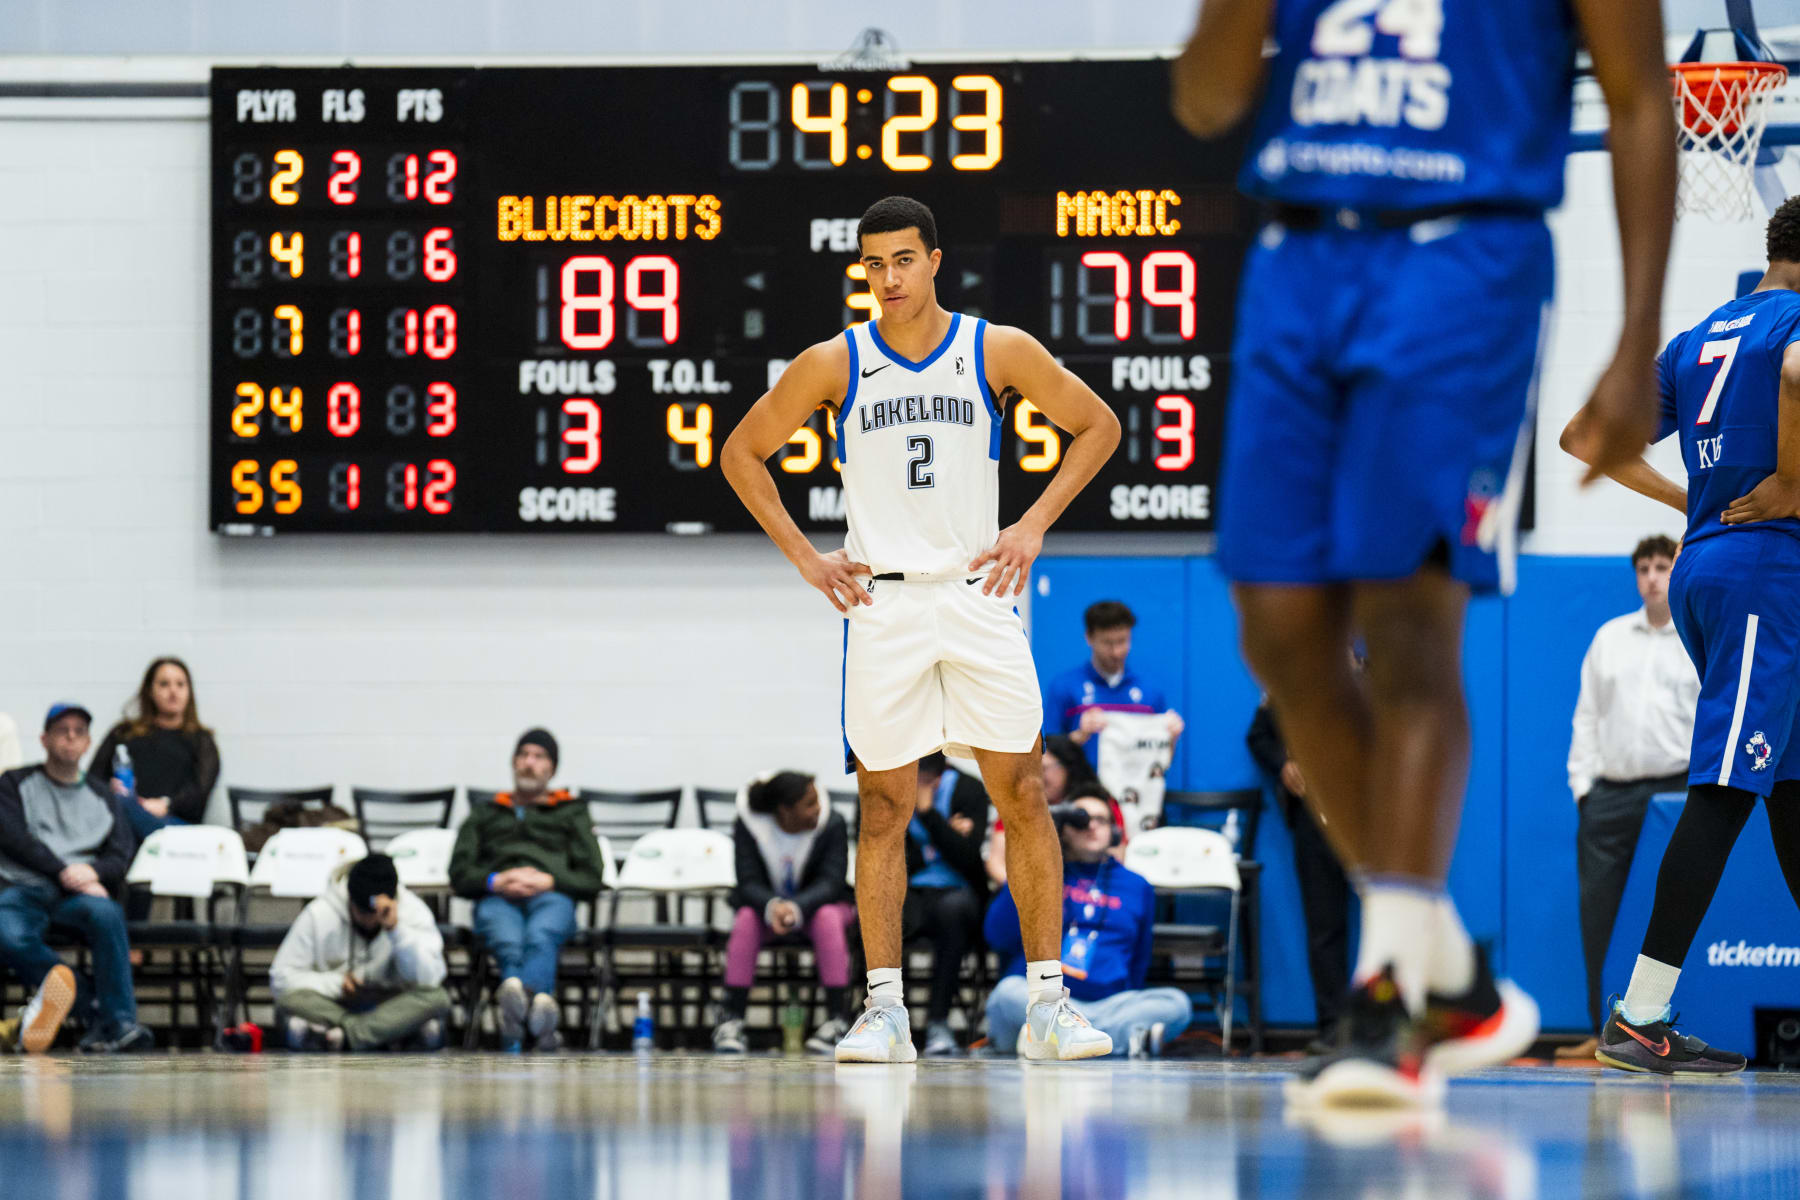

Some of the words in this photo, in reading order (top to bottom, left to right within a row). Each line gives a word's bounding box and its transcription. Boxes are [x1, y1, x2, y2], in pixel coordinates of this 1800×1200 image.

[1311, 0, 1444, 58] 24
[236, 89, 296, 122] PLYR
[322, 89, 365, 122] FLS
[397, 89, 443, 122] PTS
[791, 74, 1002, 171] 4:23
[270, 150, 304, 205] 2
[328, 150, 361, 205] 2
[405, 150, 458, 205] 12
[498, 195, 721, 241] BLUECOATS
[810, 218, 862, 252] PER
[1057, 190, 1181, 236] MAGIC
[270, 231, 303, 278] 4
[348, 231, 361, 278] 1
[423, 227, 457, 282] 6
[560, 255, 679, 349] 89
[1081, 252, 1196, 341] 79
[274, 304, 303, 356] 7
[347, 309, 361, 355] 1
[405, 304, 457, 360] 10
[519, 360, 616, 394] FOULS
[648, 359, 731, 394] T.O.L.
[1112, 356, 1211, 391] FOULS
[1696, 335, 1742, 426] 7
[231, 382, 303, 437] 24
[327, 382, 361, 437] 0
[427, 382, 457, 437] 3
[561, 398, 601, 473] 3
[666, 402, 712, 468] 4
[859, 395, 975, 434] LAKELAND
[1014, 399, 1060, 472] 5
[1155, 395, 1195, 471] 3
[231, 459, 302, 514] 55
[347, 463, 361, 510] 1
[404, 459, 456, 514] 12
[906, 434, 935, 489] 2
[519, 487, 616, 522] SCORE
[1110, 484, 1210, 519] SCORE
[1707, 939, 1800, 967] ticketm
